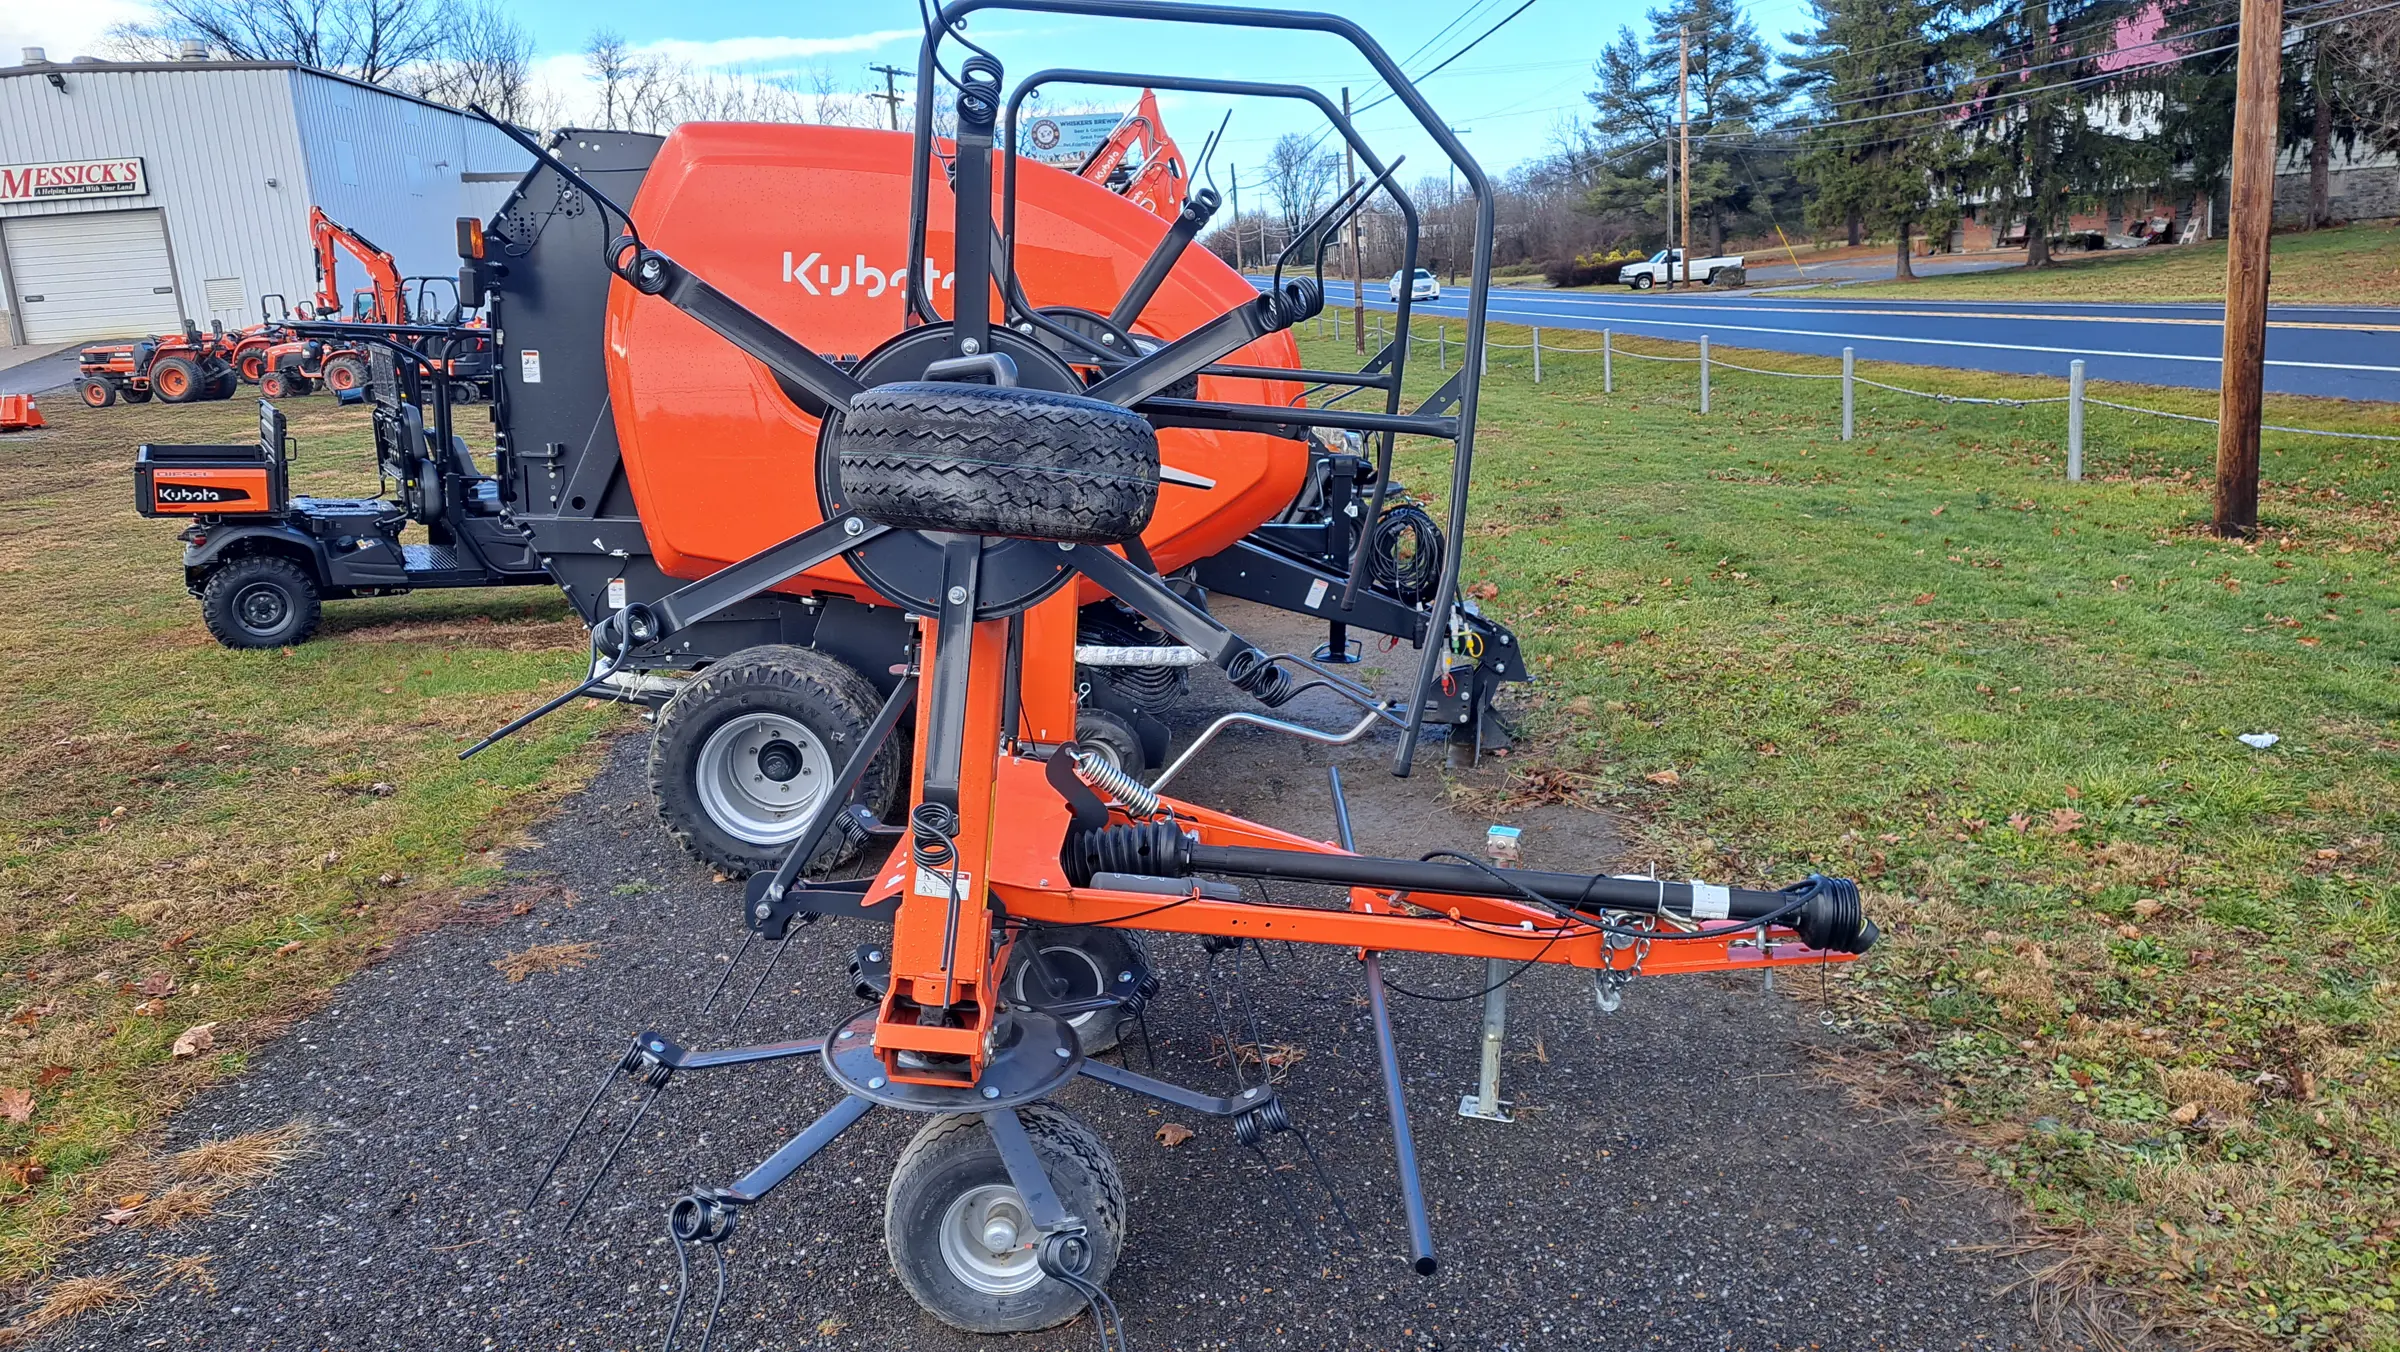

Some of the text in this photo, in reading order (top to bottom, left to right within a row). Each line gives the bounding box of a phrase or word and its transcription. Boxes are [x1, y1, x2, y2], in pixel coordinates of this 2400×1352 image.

[1094, 151, 1120, 180] Kubota
[0, 162, 137, 199] MESSICK'S
[42, 187, 66, 196] Helping
[68, 186, 85, 194] Hand
[159, 488, 220, 501] Kubota
